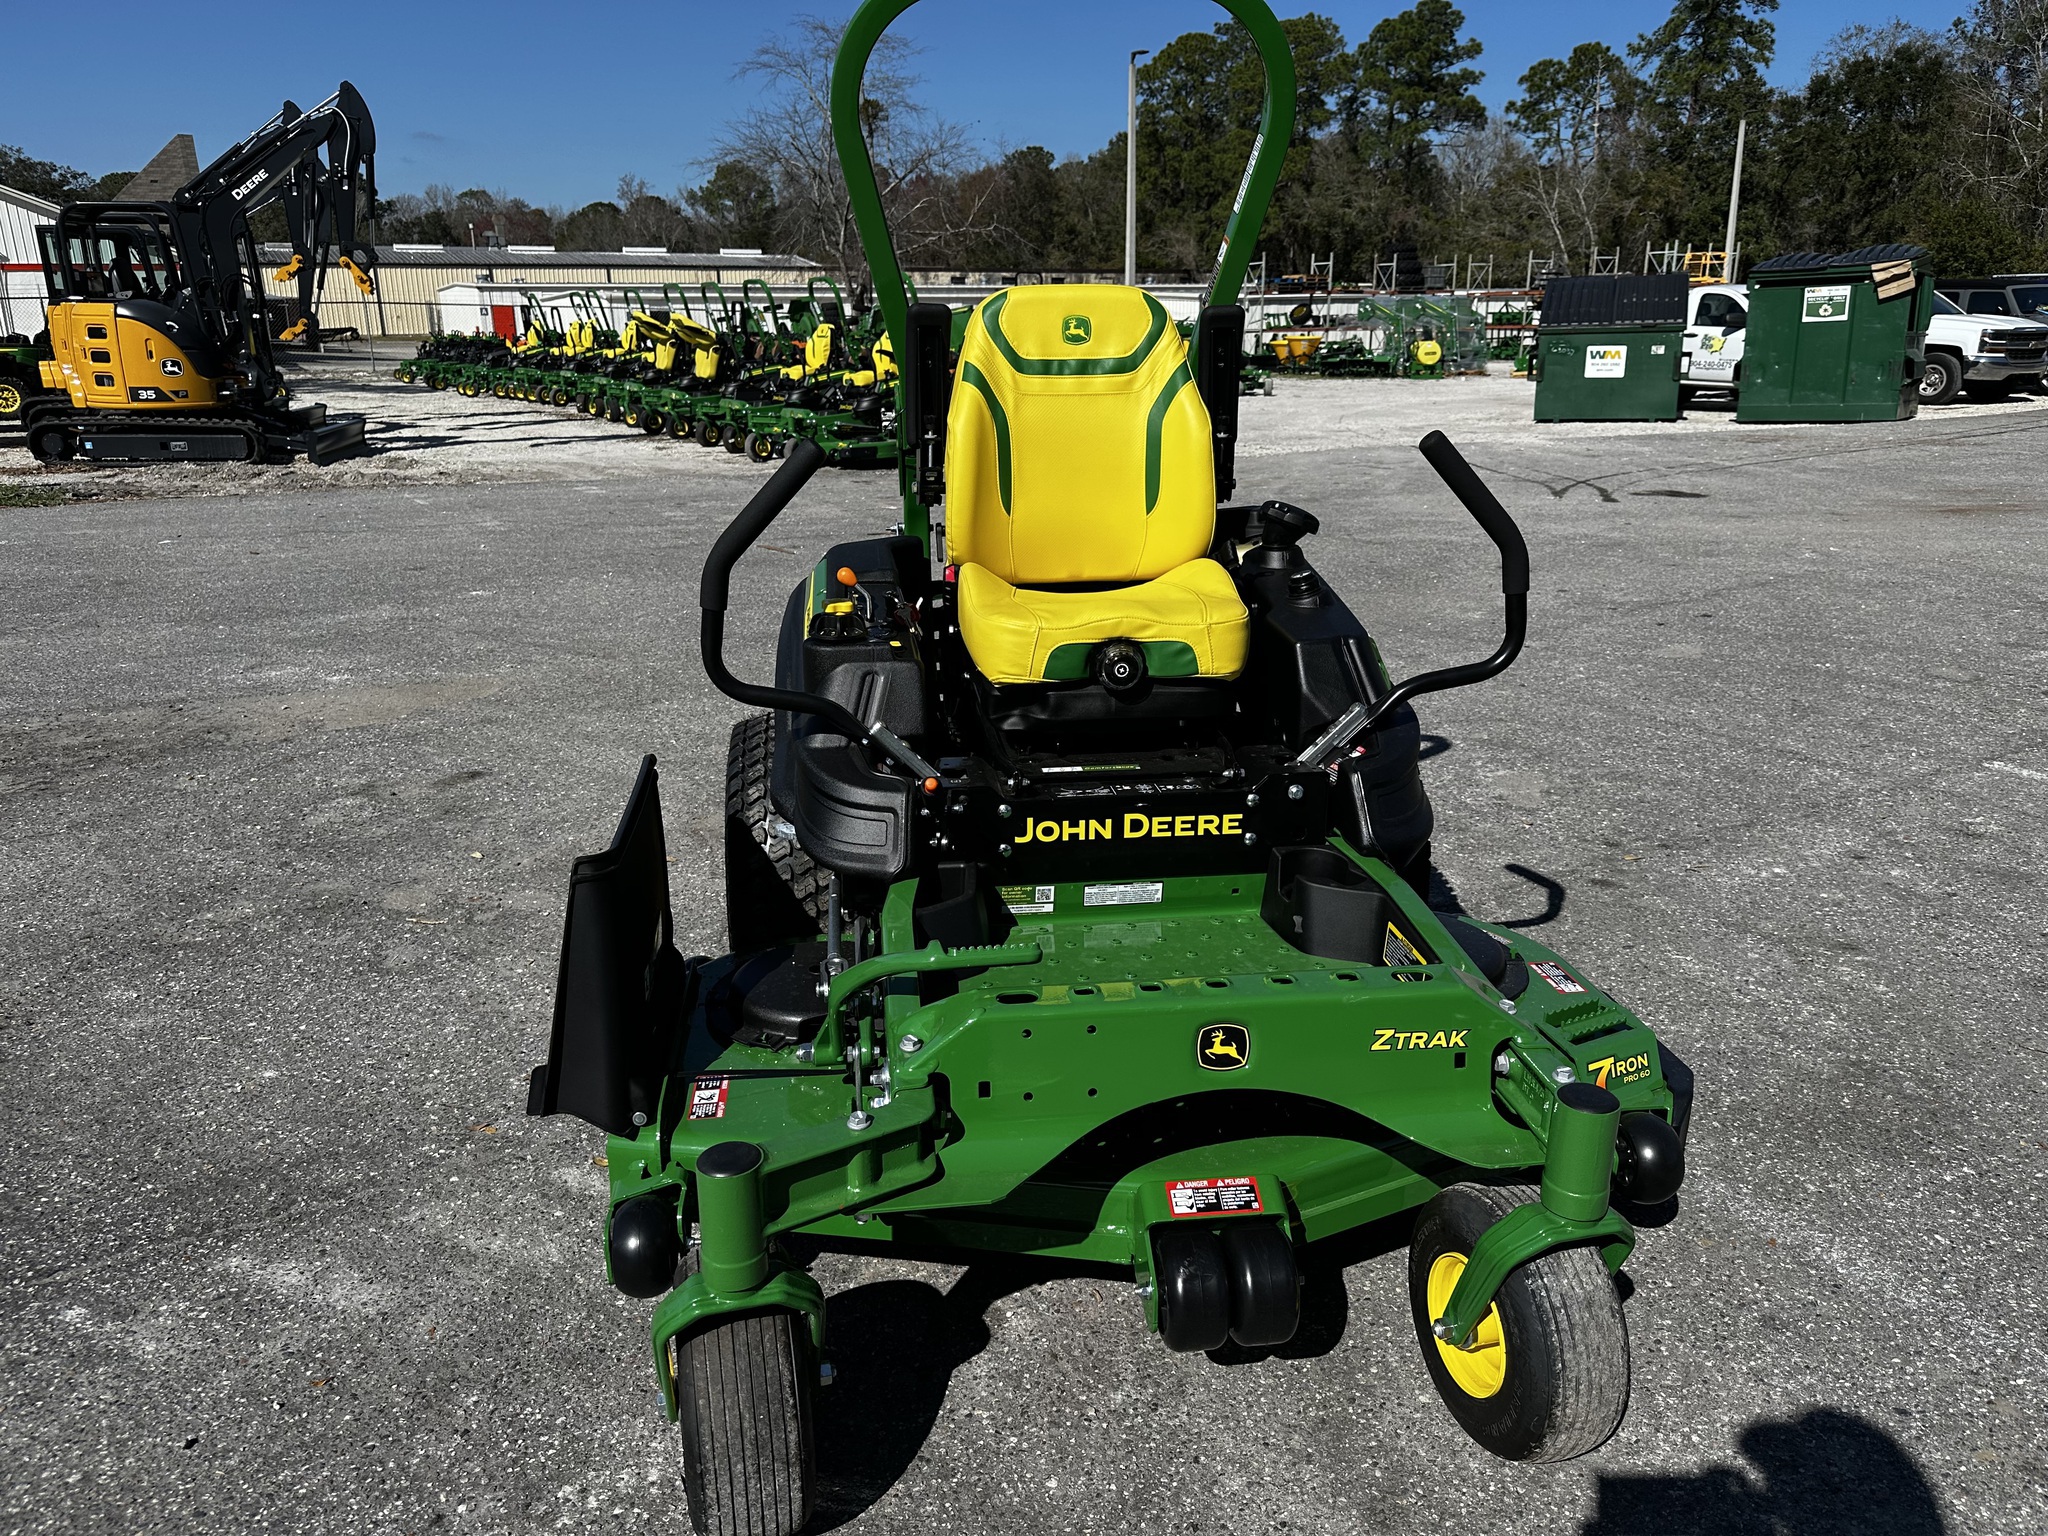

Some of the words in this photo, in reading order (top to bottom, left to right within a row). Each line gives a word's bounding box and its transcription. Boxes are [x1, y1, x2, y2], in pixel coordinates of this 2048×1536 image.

[231, 168, 269, 201] DEERE
[1589, 350, 1622, 360] WM
[138, 390, 156, 399] 35
[1014, 817, 1112, 844] JOHN
[1123, 813, 1243, 839] DEERE
[1370, 1028, 1470, 1051] ZTRAK
[1623, 1073, 1639, 1084] PRO
[1640, 1069, 1651, 1078] 60
[1184, 1180, 1209, 1188] DANGER
[1224, 1177, 1250, 1186] PELIGRO
